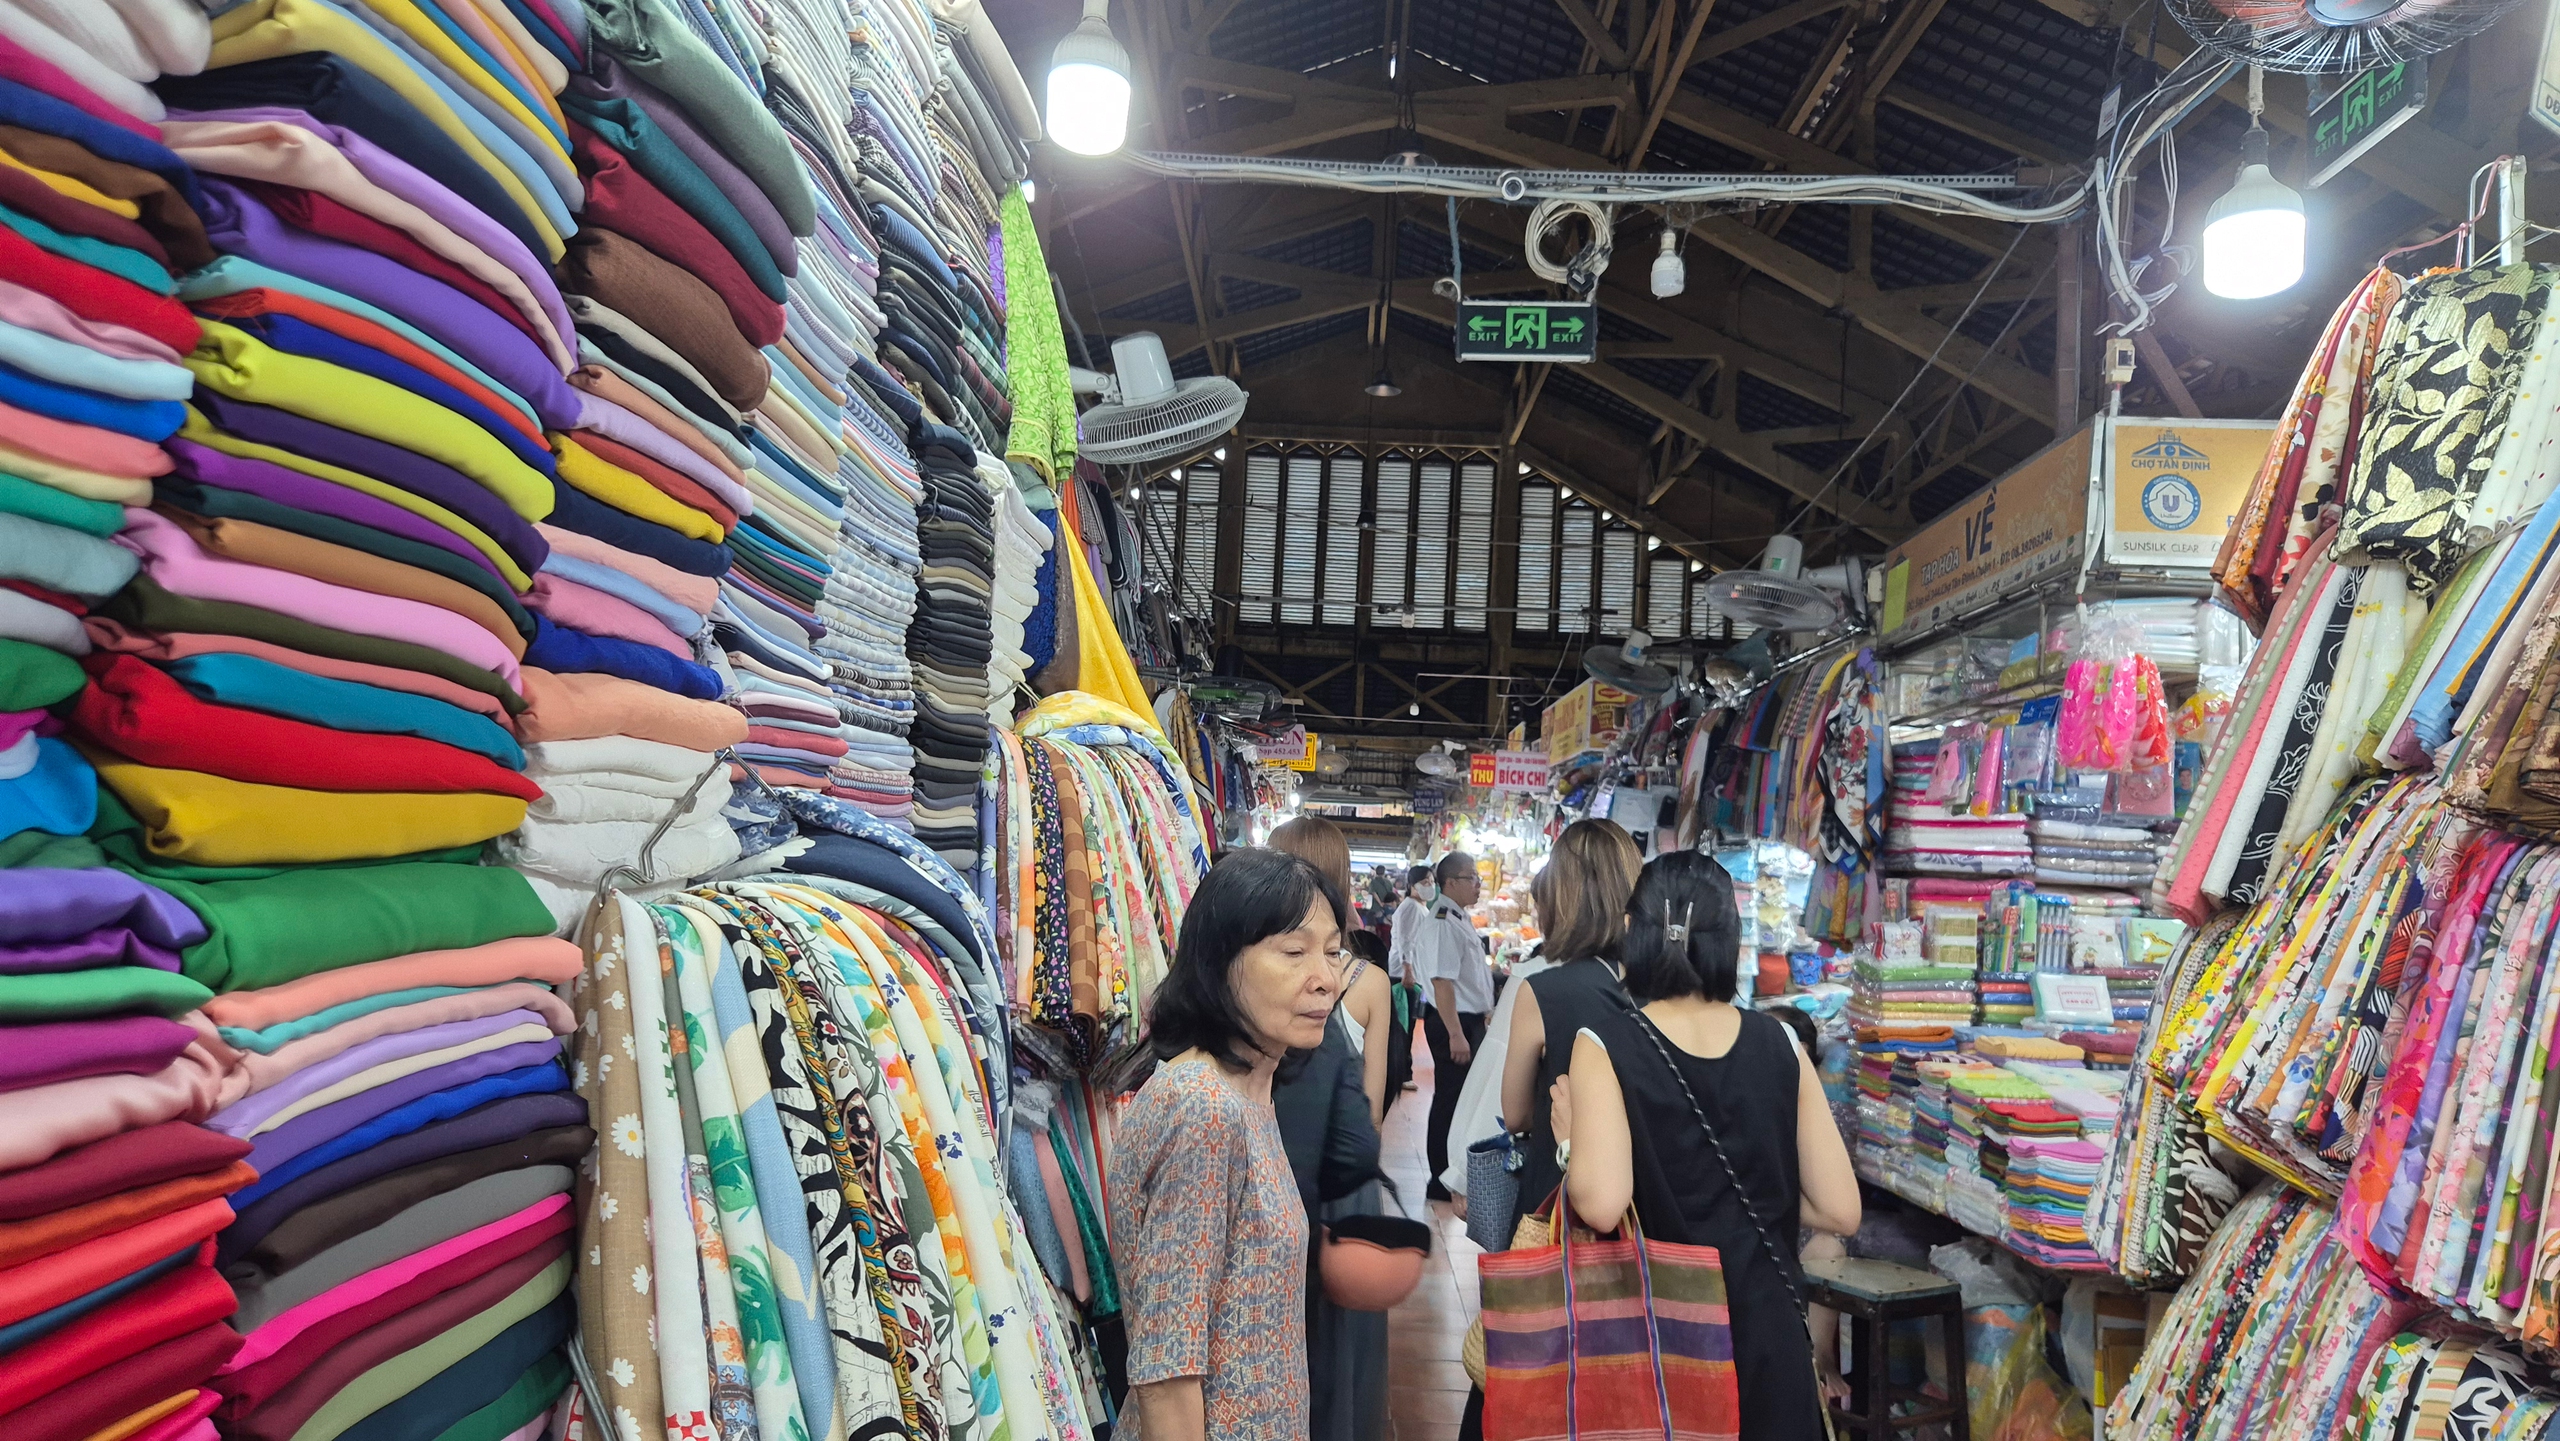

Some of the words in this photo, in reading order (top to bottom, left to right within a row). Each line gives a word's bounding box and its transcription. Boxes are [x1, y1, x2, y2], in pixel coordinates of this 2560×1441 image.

[2378, 79, 2405, 108] EXIT
[2315, 133, 2339, 158] EXIT
[1468, 332, 1499, 341] EXIT
[1552, 333, 1583, 342] EXIT
[2131, 459, 2155, 470] CHỢ
[2157, 457, 2179, 469] TÂN
[2182, 460, 2211, 472] ĐỊNH
[2123, 542, 2166, 552] SUNSILK
[2171, 543, 2199, 553] CLEAR
[1472, 769, 1494, 784] THU
[1498, 766, 1525, 786] BÍCH
[1526, 771, 1546, 787] CHI
